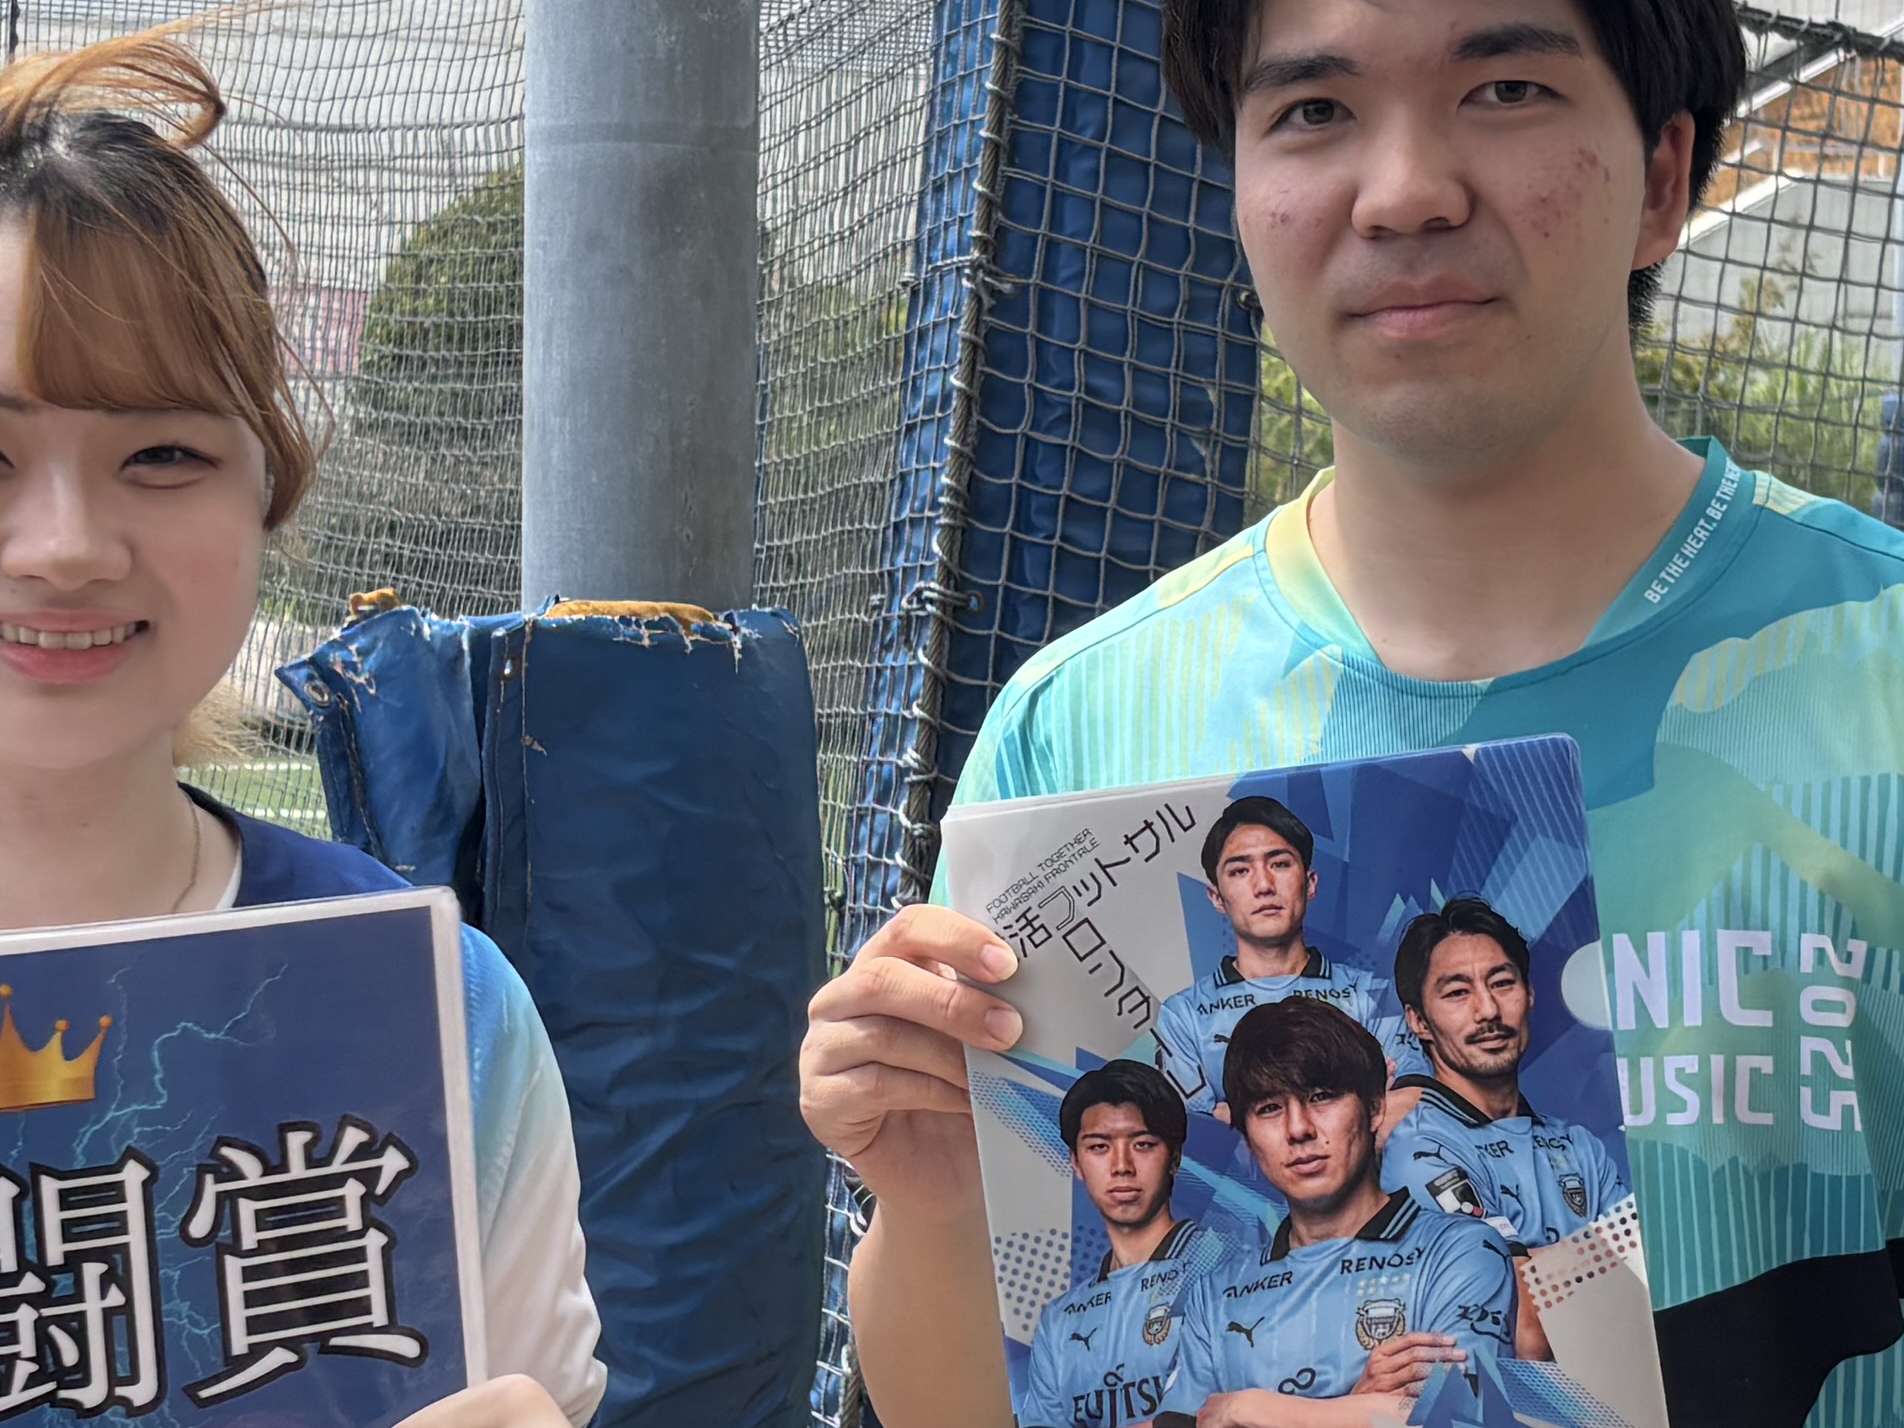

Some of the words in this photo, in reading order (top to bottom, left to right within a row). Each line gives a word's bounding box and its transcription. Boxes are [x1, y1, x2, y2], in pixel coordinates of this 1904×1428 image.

[1644, 579, 1669, 604] BE
[1659, 553, 1690, 584] THE
[1705, 498, 1728, 521] BE
[995, 803, 1196, 957] 活フットサル
[1197, 993, 1256, 1016] ANKER
[1799, 933, 1867, 1132] 2025
[1222, 1271, 1293, 1298] ANKER
[1340, 1247, 1426, 1275] RENOSY
